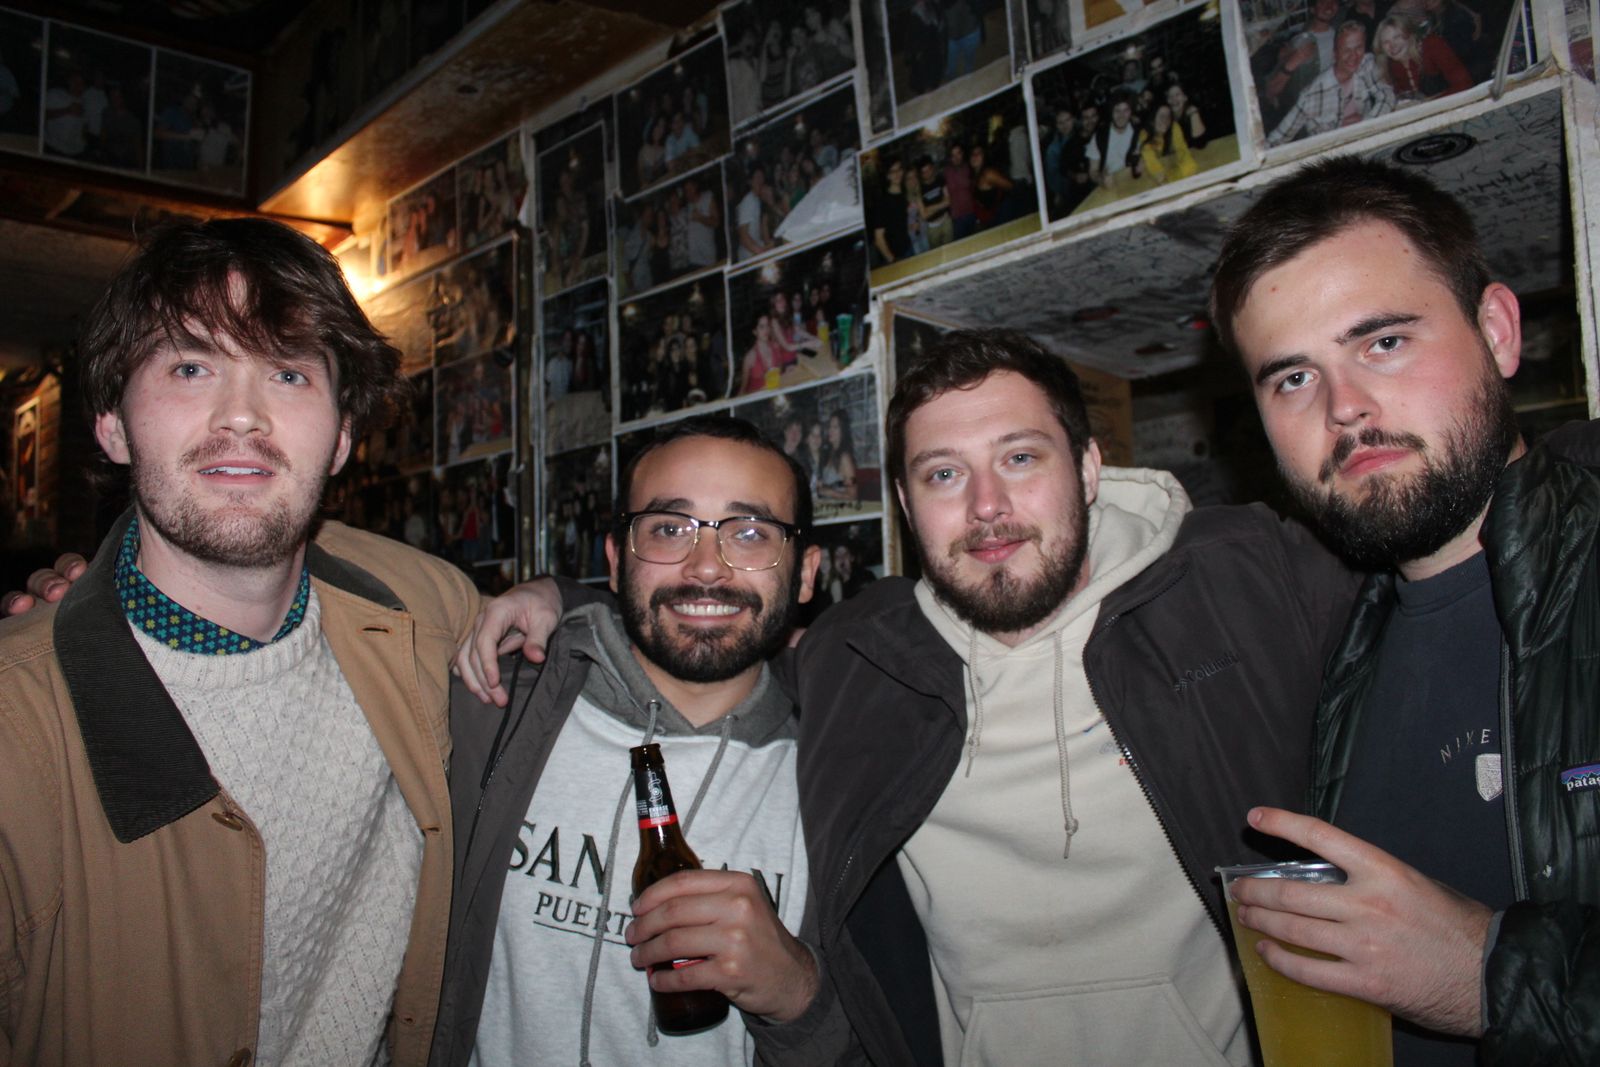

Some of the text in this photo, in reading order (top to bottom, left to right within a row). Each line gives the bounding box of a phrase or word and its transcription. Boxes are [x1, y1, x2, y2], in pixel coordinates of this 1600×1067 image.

[1439, 728, 1491, 764] NIKE
[509, 821, 607, 895] SAN
[534, 891, 634, 937] PUERT
